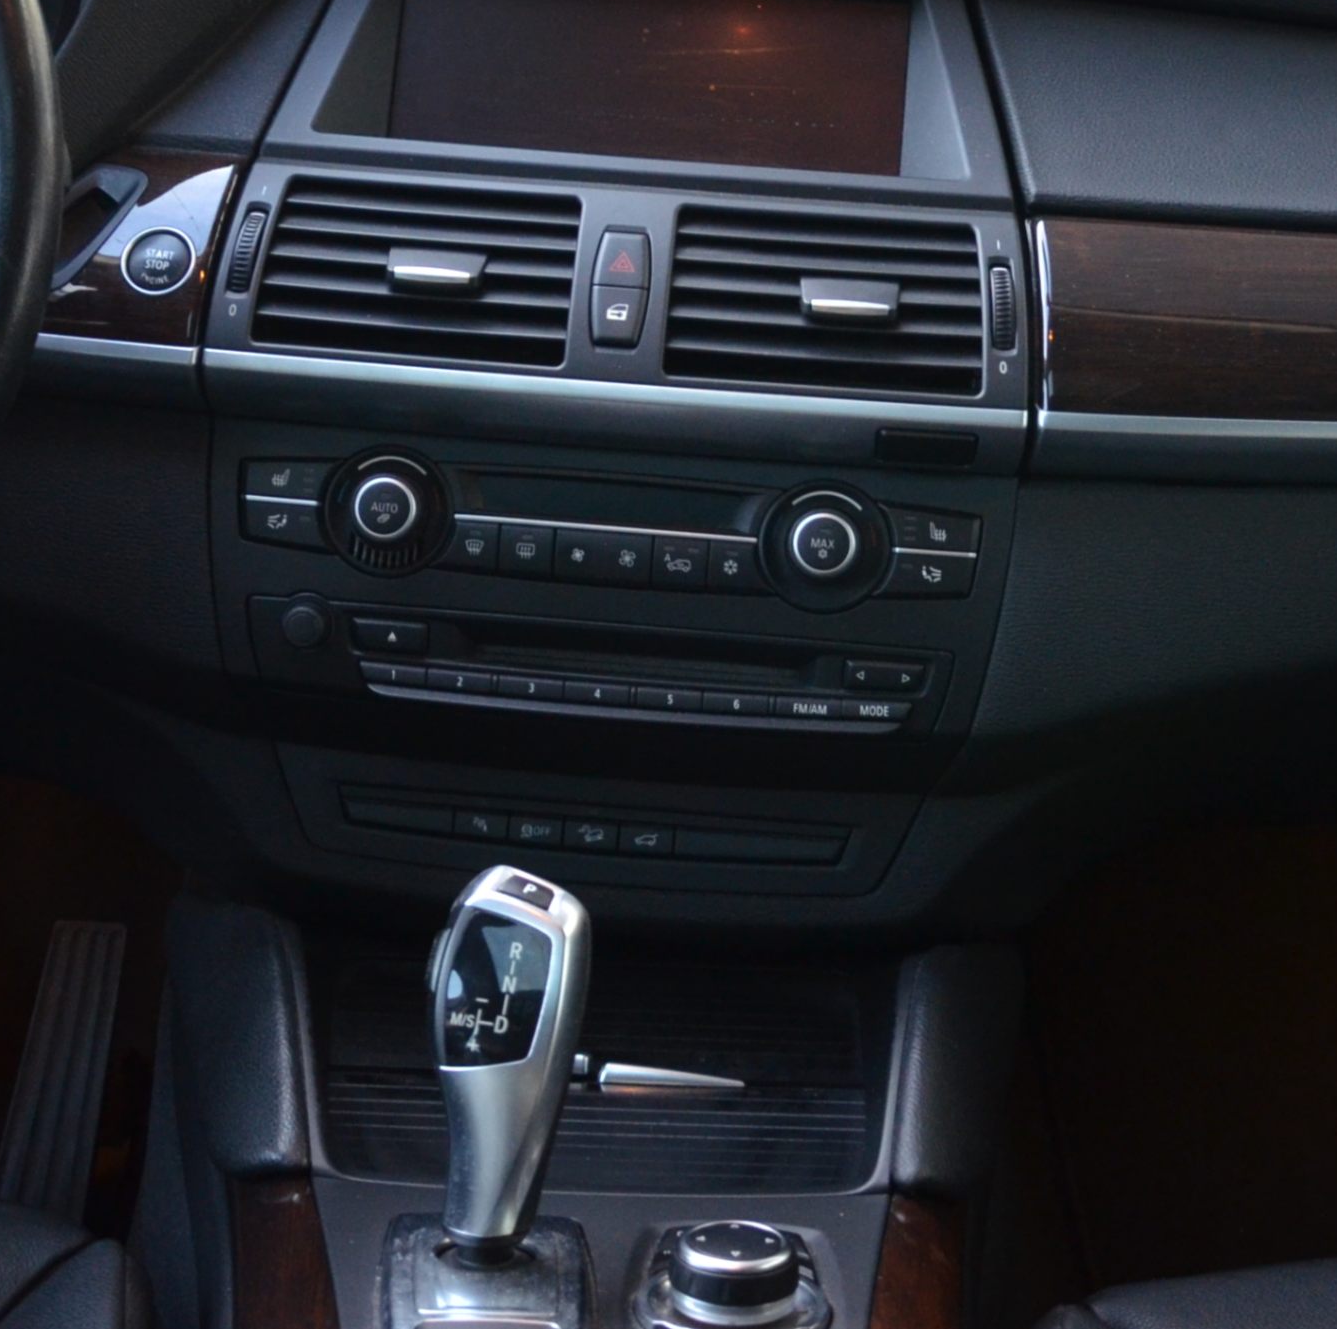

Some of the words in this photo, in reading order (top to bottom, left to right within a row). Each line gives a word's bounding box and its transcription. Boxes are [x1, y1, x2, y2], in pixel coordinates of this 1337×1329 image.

[145, 248, 175, 260] START
[145, 258, 170, 271] STOP
[371, 501, 398, 514] AUTO
[810, 537, 835, 549] MAX
[390, 669, 396, 681] 1
[457, 676, 464, 688] 2
[528, 682, 536, 694] 3
[594, 688, 601, 699] 4
[666, 694, 673, 705] 5
[733, 698, 740, 710] 6
[793, 702, 828, 715] FM/AM
[859, 704, 890, 717] MODE
[522, 883, 538, 894] P
[509, 941, 523, 960] R
[501, 975, 518, 994] N
[449, 1011, 476, 1028] M/S
[493, 1015, 509, 1034] D
